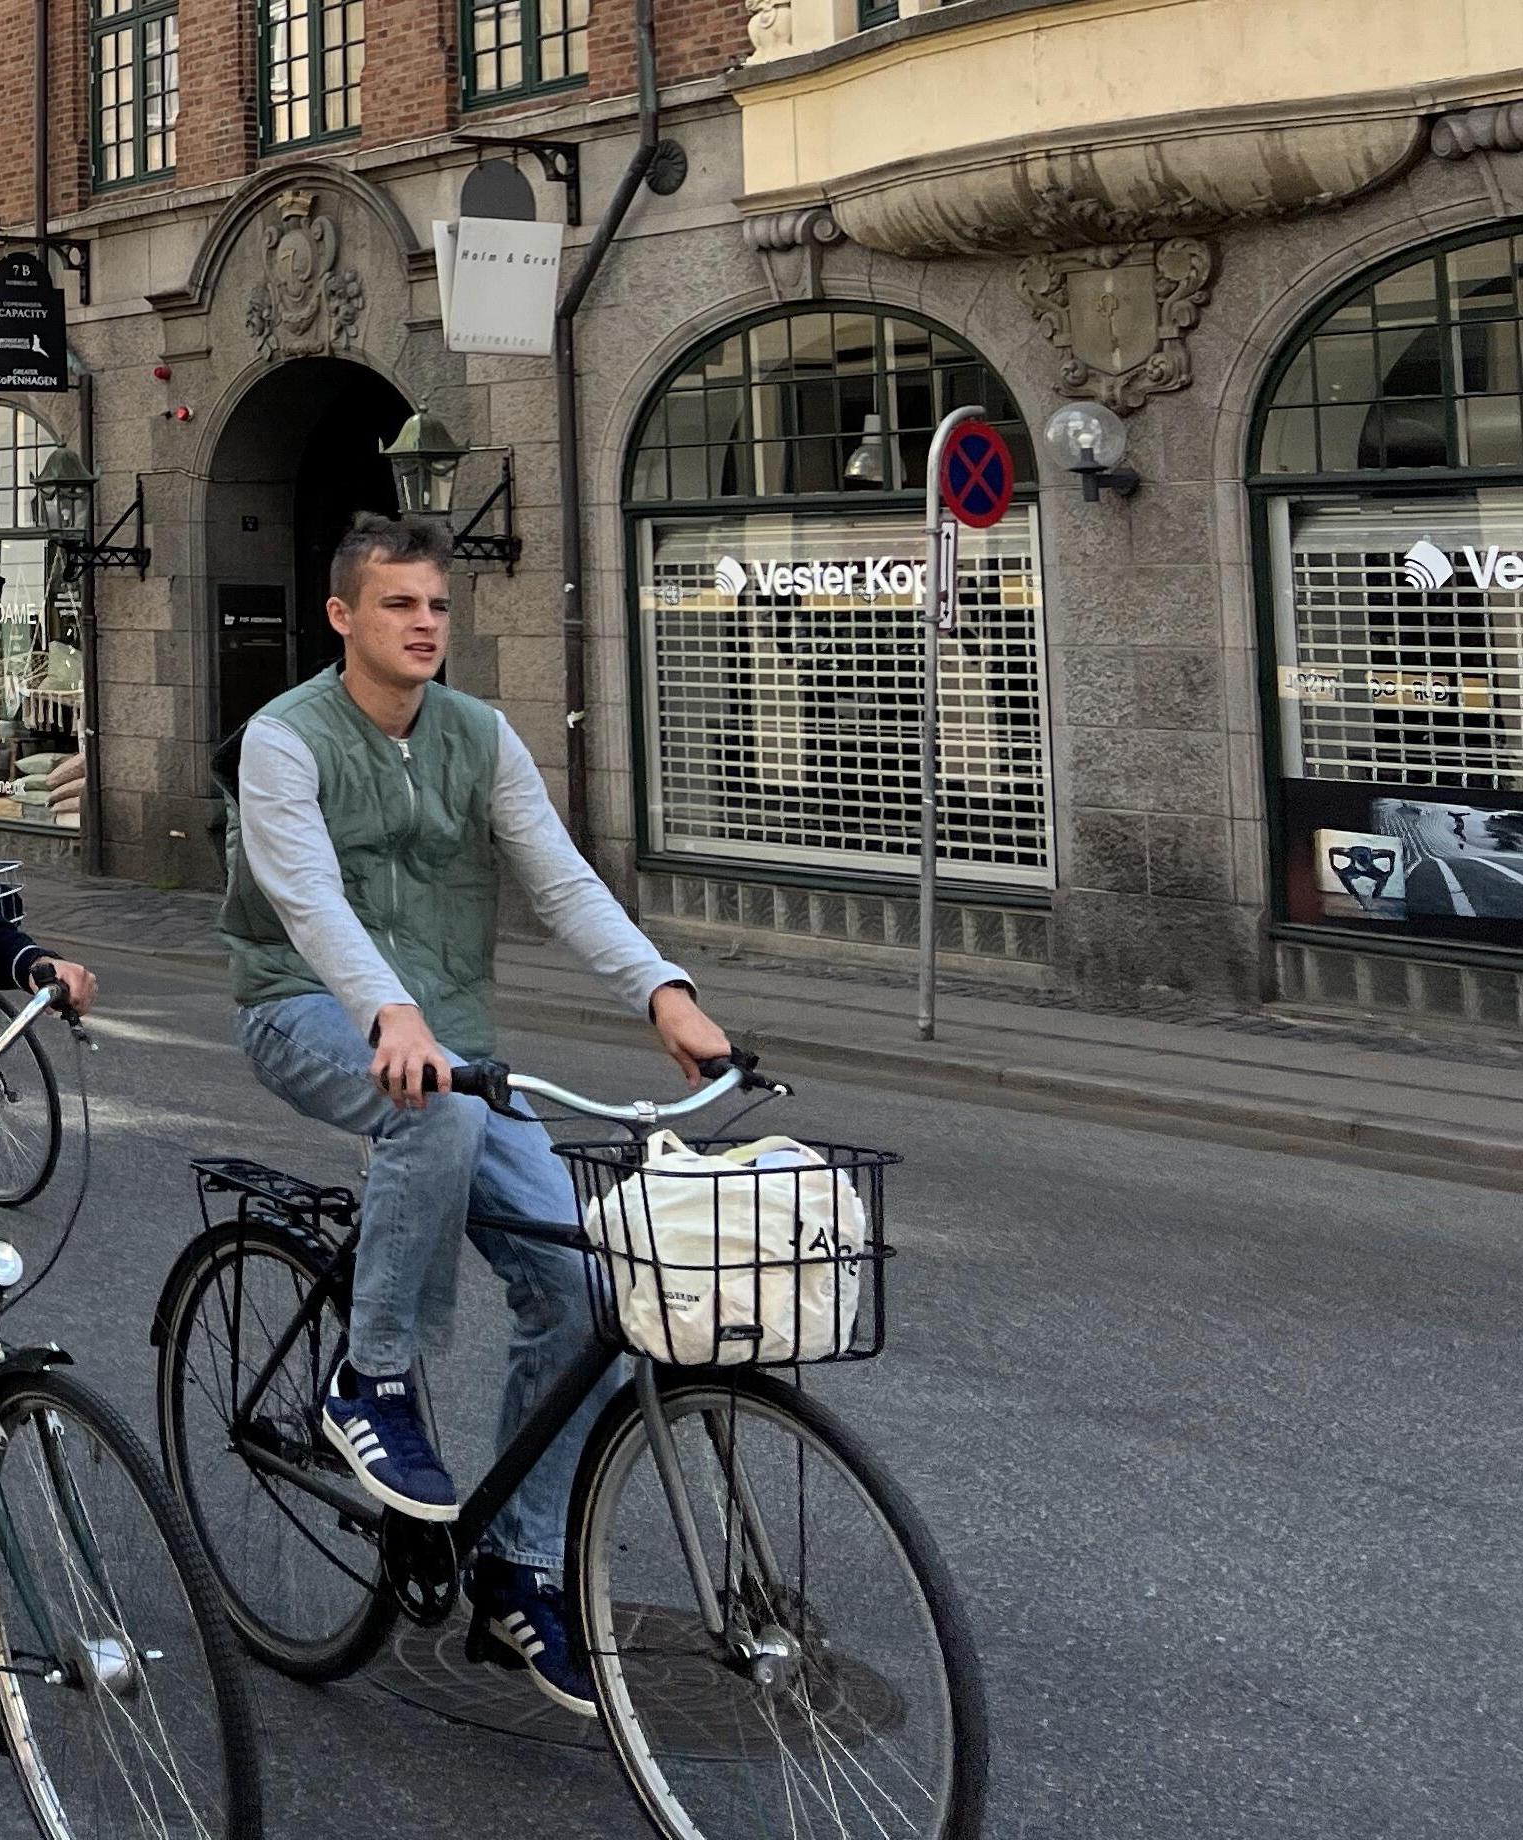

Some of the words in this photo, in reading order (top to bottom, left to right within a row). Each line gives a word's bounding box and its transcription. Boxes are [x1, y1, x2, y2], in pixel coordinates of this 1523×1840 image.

[506, 252, 514, 263] &
[22, 264, 31, 276] B
[753, 557, 858, 597] Vester
